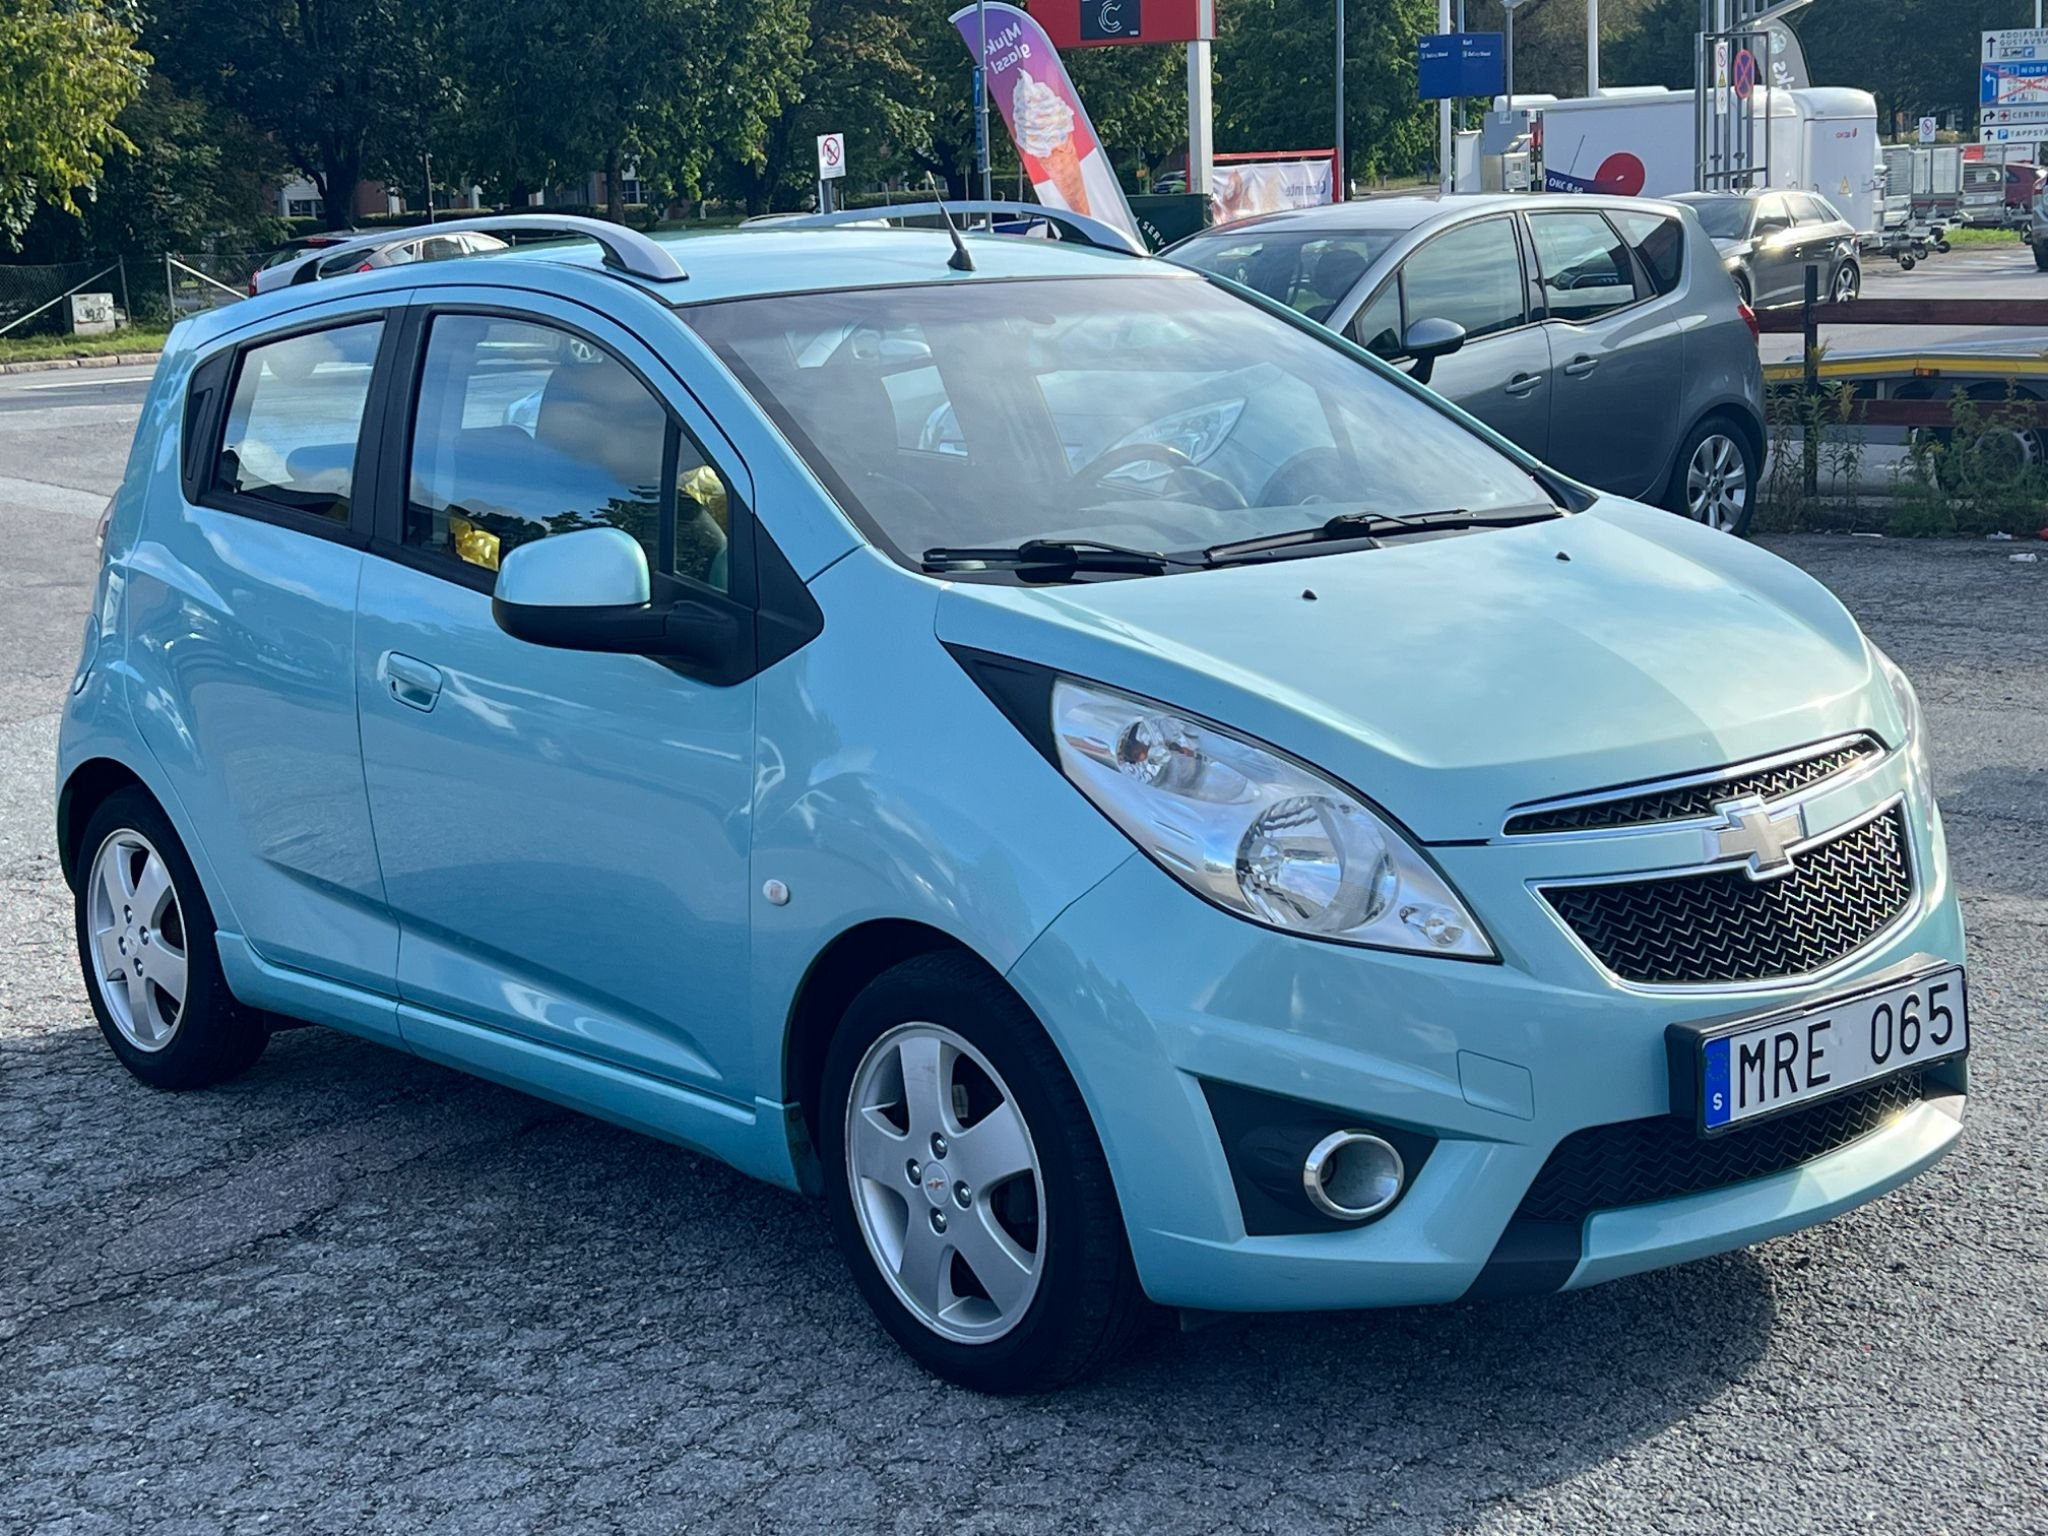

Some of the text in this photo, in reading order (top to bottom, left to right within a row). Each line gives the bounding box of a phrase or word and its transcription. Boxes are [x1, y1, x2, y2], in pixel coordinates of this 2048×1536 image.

[2012, 110, 2048, 119] CENTRU
[1739, 982, 1953, 1109] MRE 065
[1712, 1092, 1723, 1112] S
